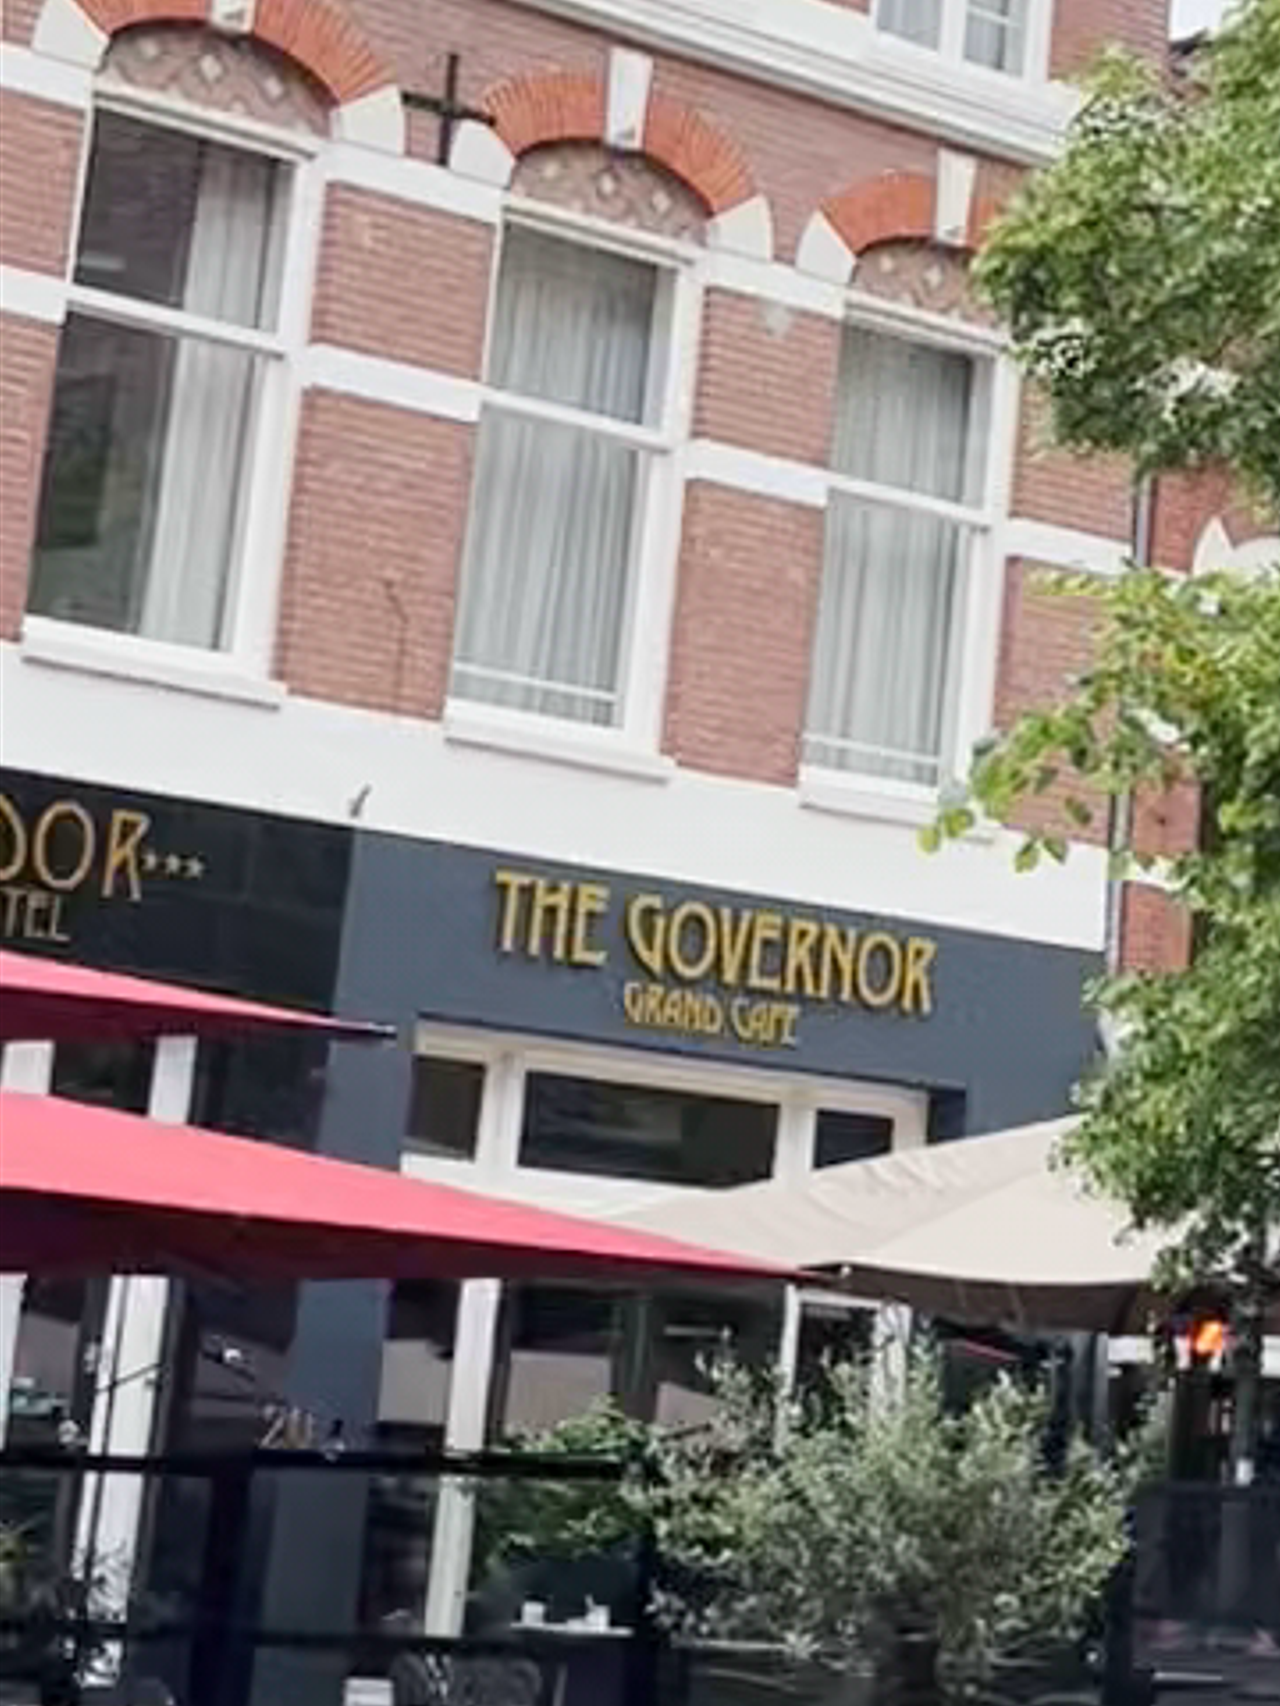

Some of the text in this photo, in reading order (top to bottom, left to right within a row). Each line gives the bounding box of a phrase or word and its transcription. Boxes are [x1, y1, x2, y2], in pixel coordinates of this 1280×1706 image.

[496, 869, 936, 1016] THE GOVERNOR
[624, 981, 724, 1034] GRAND
